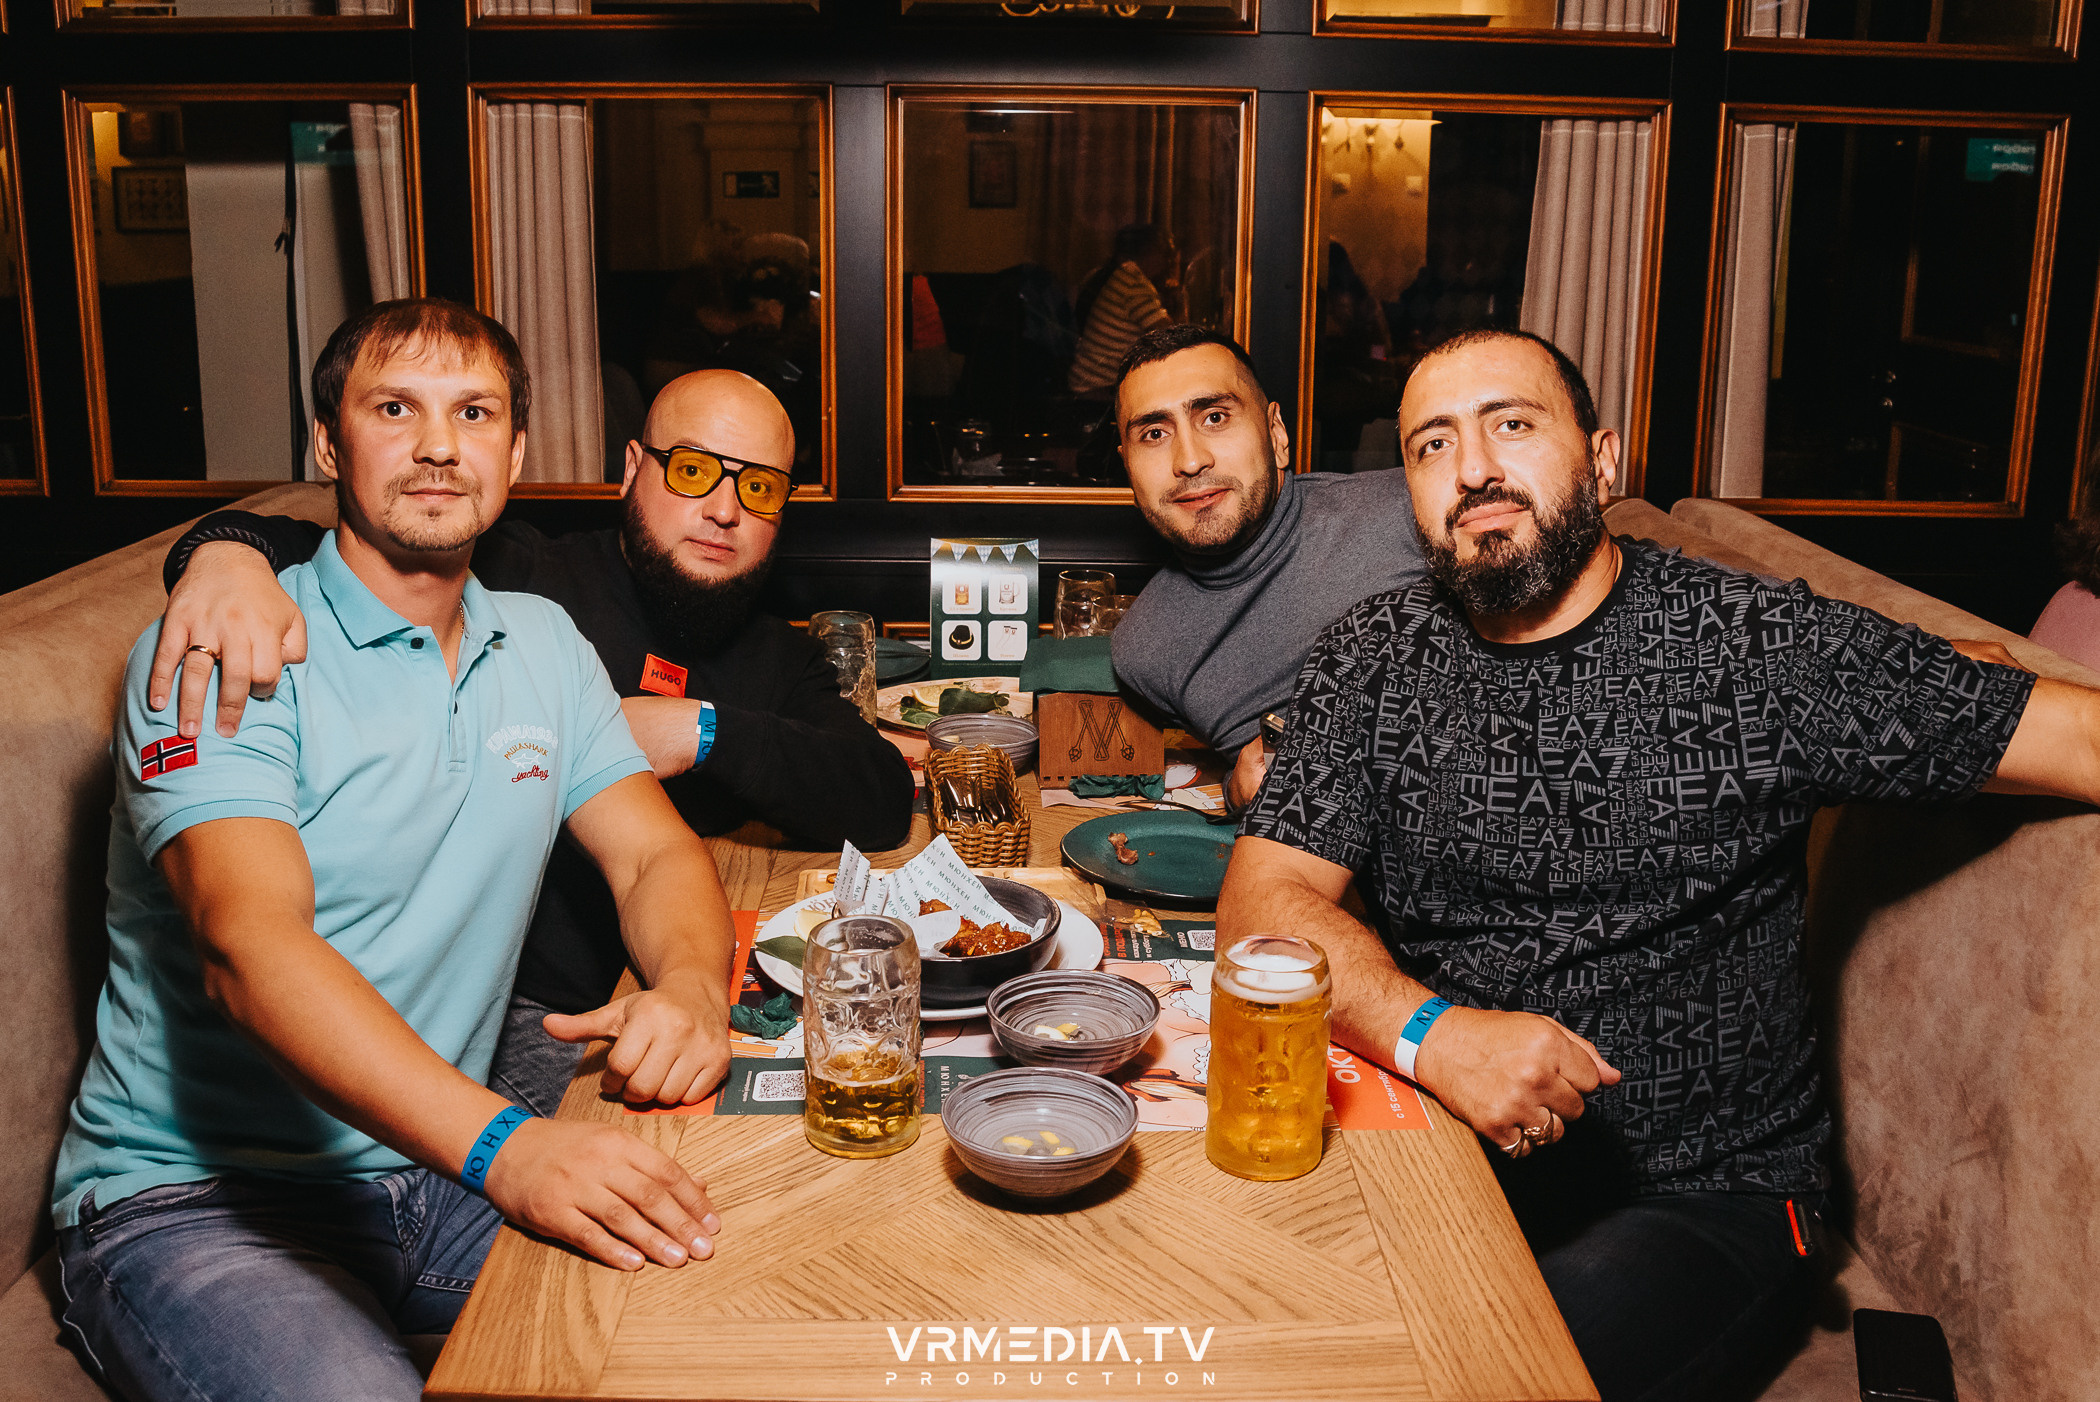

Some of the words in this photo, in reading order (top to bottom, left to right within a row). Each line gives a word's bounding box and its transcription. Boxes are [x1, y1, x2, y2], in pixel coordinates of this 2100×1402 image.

[1634, 601, 1660, 610] EA7
[1757, 590, 1793, 651] EA7
[1389, 633, 1415, 646] EA7
[1421, 612, 1452, 675] EA7
[1639, 609, 1663, 669] EA7
[1698, 635, 1719, 651] EA7
[1723, 626, 1746, 641] EA7
[1533, 655, 1559, 666] EA7
[1617, 653, 1628, 675] EA7
[1665, 641, 1679, 669] EA7
[1682, 642, 1696, 667] EA7
[1699, 636, 1751, 667] EA7
[1383, 660, 1401, 692] EA7
[1507, 665, 1563, 689] EA7
[1603, 654, 1613, 675] EA7
[1748, 658, 1766, 692] EA7
[651, 669, 681, 686] HUGO
[1401, 664, 1419, 696] EA7
[1605, 673, 1662, 698] EA7
[1664, 672, 1677, 695] EA7
[1676, 668, 1725, 693] EA7
[1729, 661, 1747, 695] EA7
[1304, 670, 1339, 735] EA7
[1538, 686, 1553, 718] EA7
[1556, 685, 1570, 716] EA7
[1594, 702, 1614, 711] EA7
[1641, 695, 1665, 705] EA7
[1667, 692, 1692, 704] EA7
[1694, 688, 1718, 700] EA7
[1378, 691, 1447, 726] EA7
[1616, 697, 1627, 720] EA7
[1629, 697, 1639, 718] EA7
[1641, 707, 1665, 717] EA7
[1376, 716, 1401, 728] EA7
[1400, 720, 1424, 732] EA7
[1538, 712, 1610, 741] EA7
[1615, 715, 1660, 737] EA7
[1739, 720, 1763, 733] EA7
[1373, 726, 1455, 769] EA7
[1459, 729, 1475, 762] EA7
[1473, 734, 1487, 764] EA7
[1538, 739, 1561, 748] EA7
[1563, 740, 1587, 750] EA7
[1588, 739, 1613, 749] EA7
[1614, 736, 1639, 746] EA7
[1654, 734, 1669, 764] EA7
[1669, 707, 1704, 774] EA7
[1702, 702, 1738, 771] EA7
[1640, 735, 1654, 765] EA7
[511, 765, 549, 783] yachting
[1271, 756, 1333, 788] EA7
[1440, 762, 1457, 770] EA7
[1458, 760, 1486, 773] EA7
[1538, 747, 1630, 779] EA7
[1622, 770, 1640, 778] EA7
[1641, 764, 1669, 776] EA7
[1305, 786, 1331, 798] EA7
[1396, 764, 1430, 833] EA7
[1428, 770, 1441, 804] EA7
[1487, 776, 1573, 816] EA7
[1608, 780, 1625, 812] EA7
[1676, 767, 1779, 811] EA7
[1257, 787, 1342, 829] EA7
[1457, 773, 1487, 841] EA7
[1574, 779, 1610, 847] EA7
[1647, 777, 1677, 842] EA7
[1424, 814, 1434, 835] EA7
[1485, 812, 1501, 843] EA7
[1502, 813, 1518, 844] EA7
[1520, 816, 1545, 827] EA7
[1549, 817, 1570, 828] EA7
[1518, 826, 1575, 849] EA7
[1612, 823, 1624, 847] EA7
[1627, 823, 1639, 846] EA7
[1423, 836, 1480, 862] EA7
[1482, 845, 1493, 867] EA7
[1493, 849, 1544, 870] EA7
[1616, 844, 1676, 871] EA7
[1679, 844, 1693, 866] EA7
[1691, 839, 1740, 864] EA7
[931, 844, 946, 858] ХН
[947, 861, 982, 891] МЮНХЕН
[1481, 866, 1507, 879] EA7
[1508, 869, 1535, 880] EA7
[1551, 849, 1565, 882] EA7
[1566, 850, 1582, 883] EA7
[1713, 859, 1737, 872] EA7
[925, 880, 961, 910] МЮНХН
[938, 870, 970, 901] МЮНХЕН
[1603, 904, 1628, 914] EA7
[1628, 904, 1653, 914] EA7
[1600, 1016, 1648, 1036] EA7
[1687, 1000, 1713, 1070] EA7
[1623, 1036, 1637, 1069] EA7
[1638, 1035, 1651, 1068] EA7
[1656, 1005, 1683, 1075] EA7
[1390, 1103, 1402, 1112] 15
[1658, 1136, 1706, 1161] EA7
[1675, 1182, 1701, 1192] EA7
[1705, 1182, 1730, 1191] EA7
